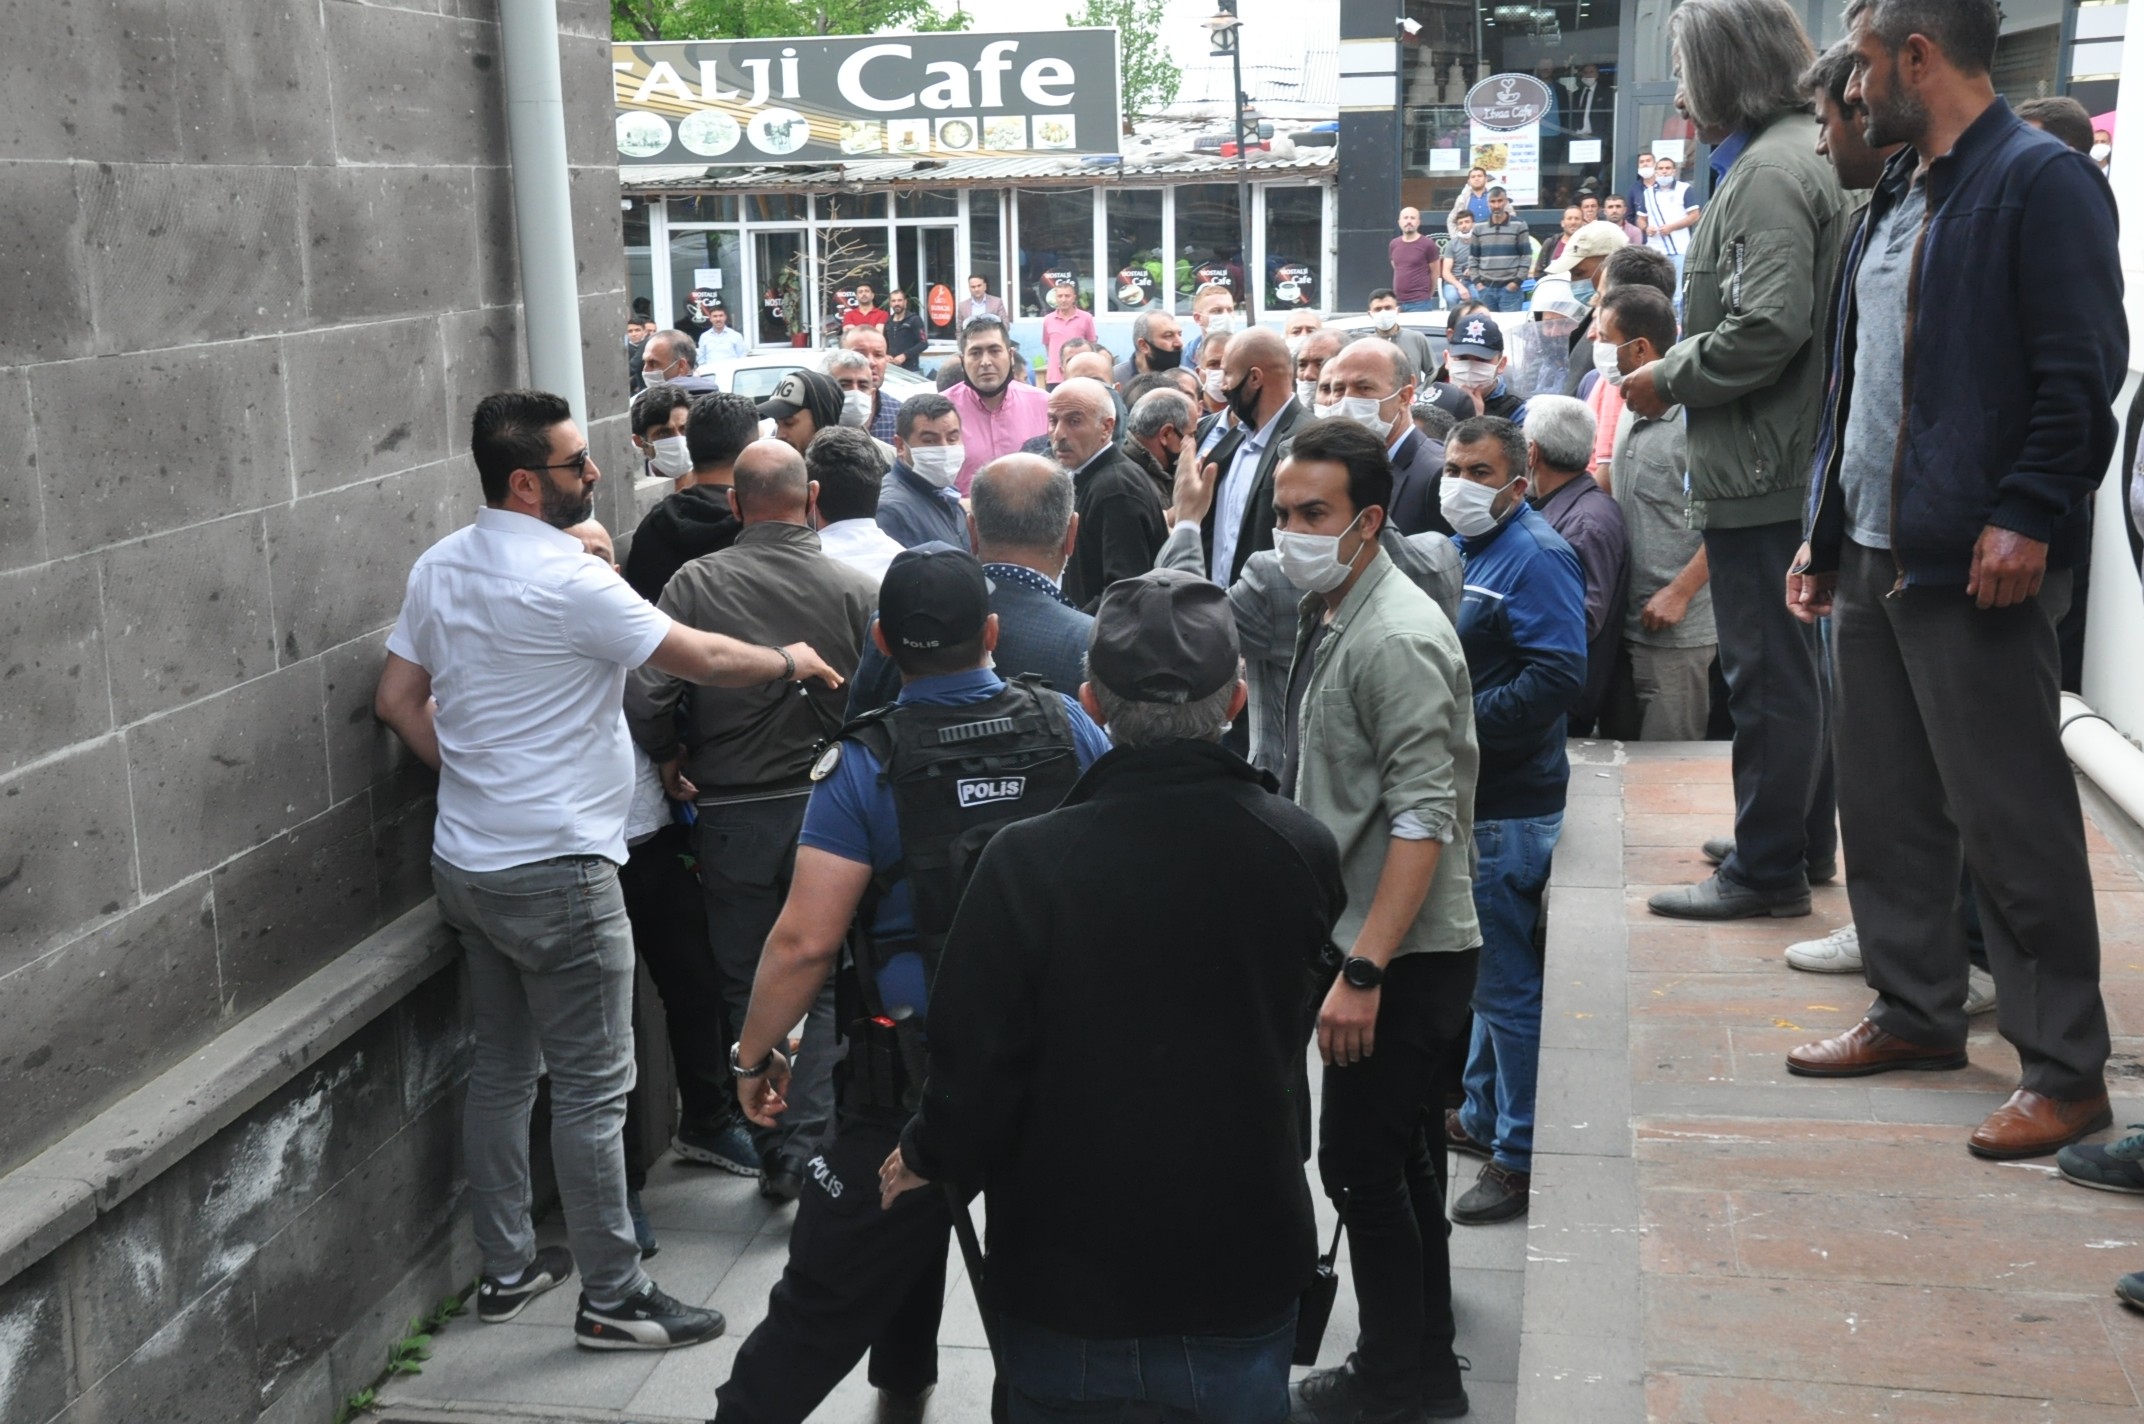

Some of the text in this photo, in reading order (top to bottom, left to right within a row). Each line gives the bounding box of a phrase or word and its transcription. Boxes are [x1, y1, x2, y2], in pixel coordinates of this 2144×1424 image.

[837, 40, 1076, 112] Cafe
[1131, 277, 1152, 286] Cafe
[1211, 276, 1232, 285] Cafe
[1291, 275, 1312, 284] Cafe
[847, 297, 859, 306] Ca
[772, 307, 784, 318] Ca
